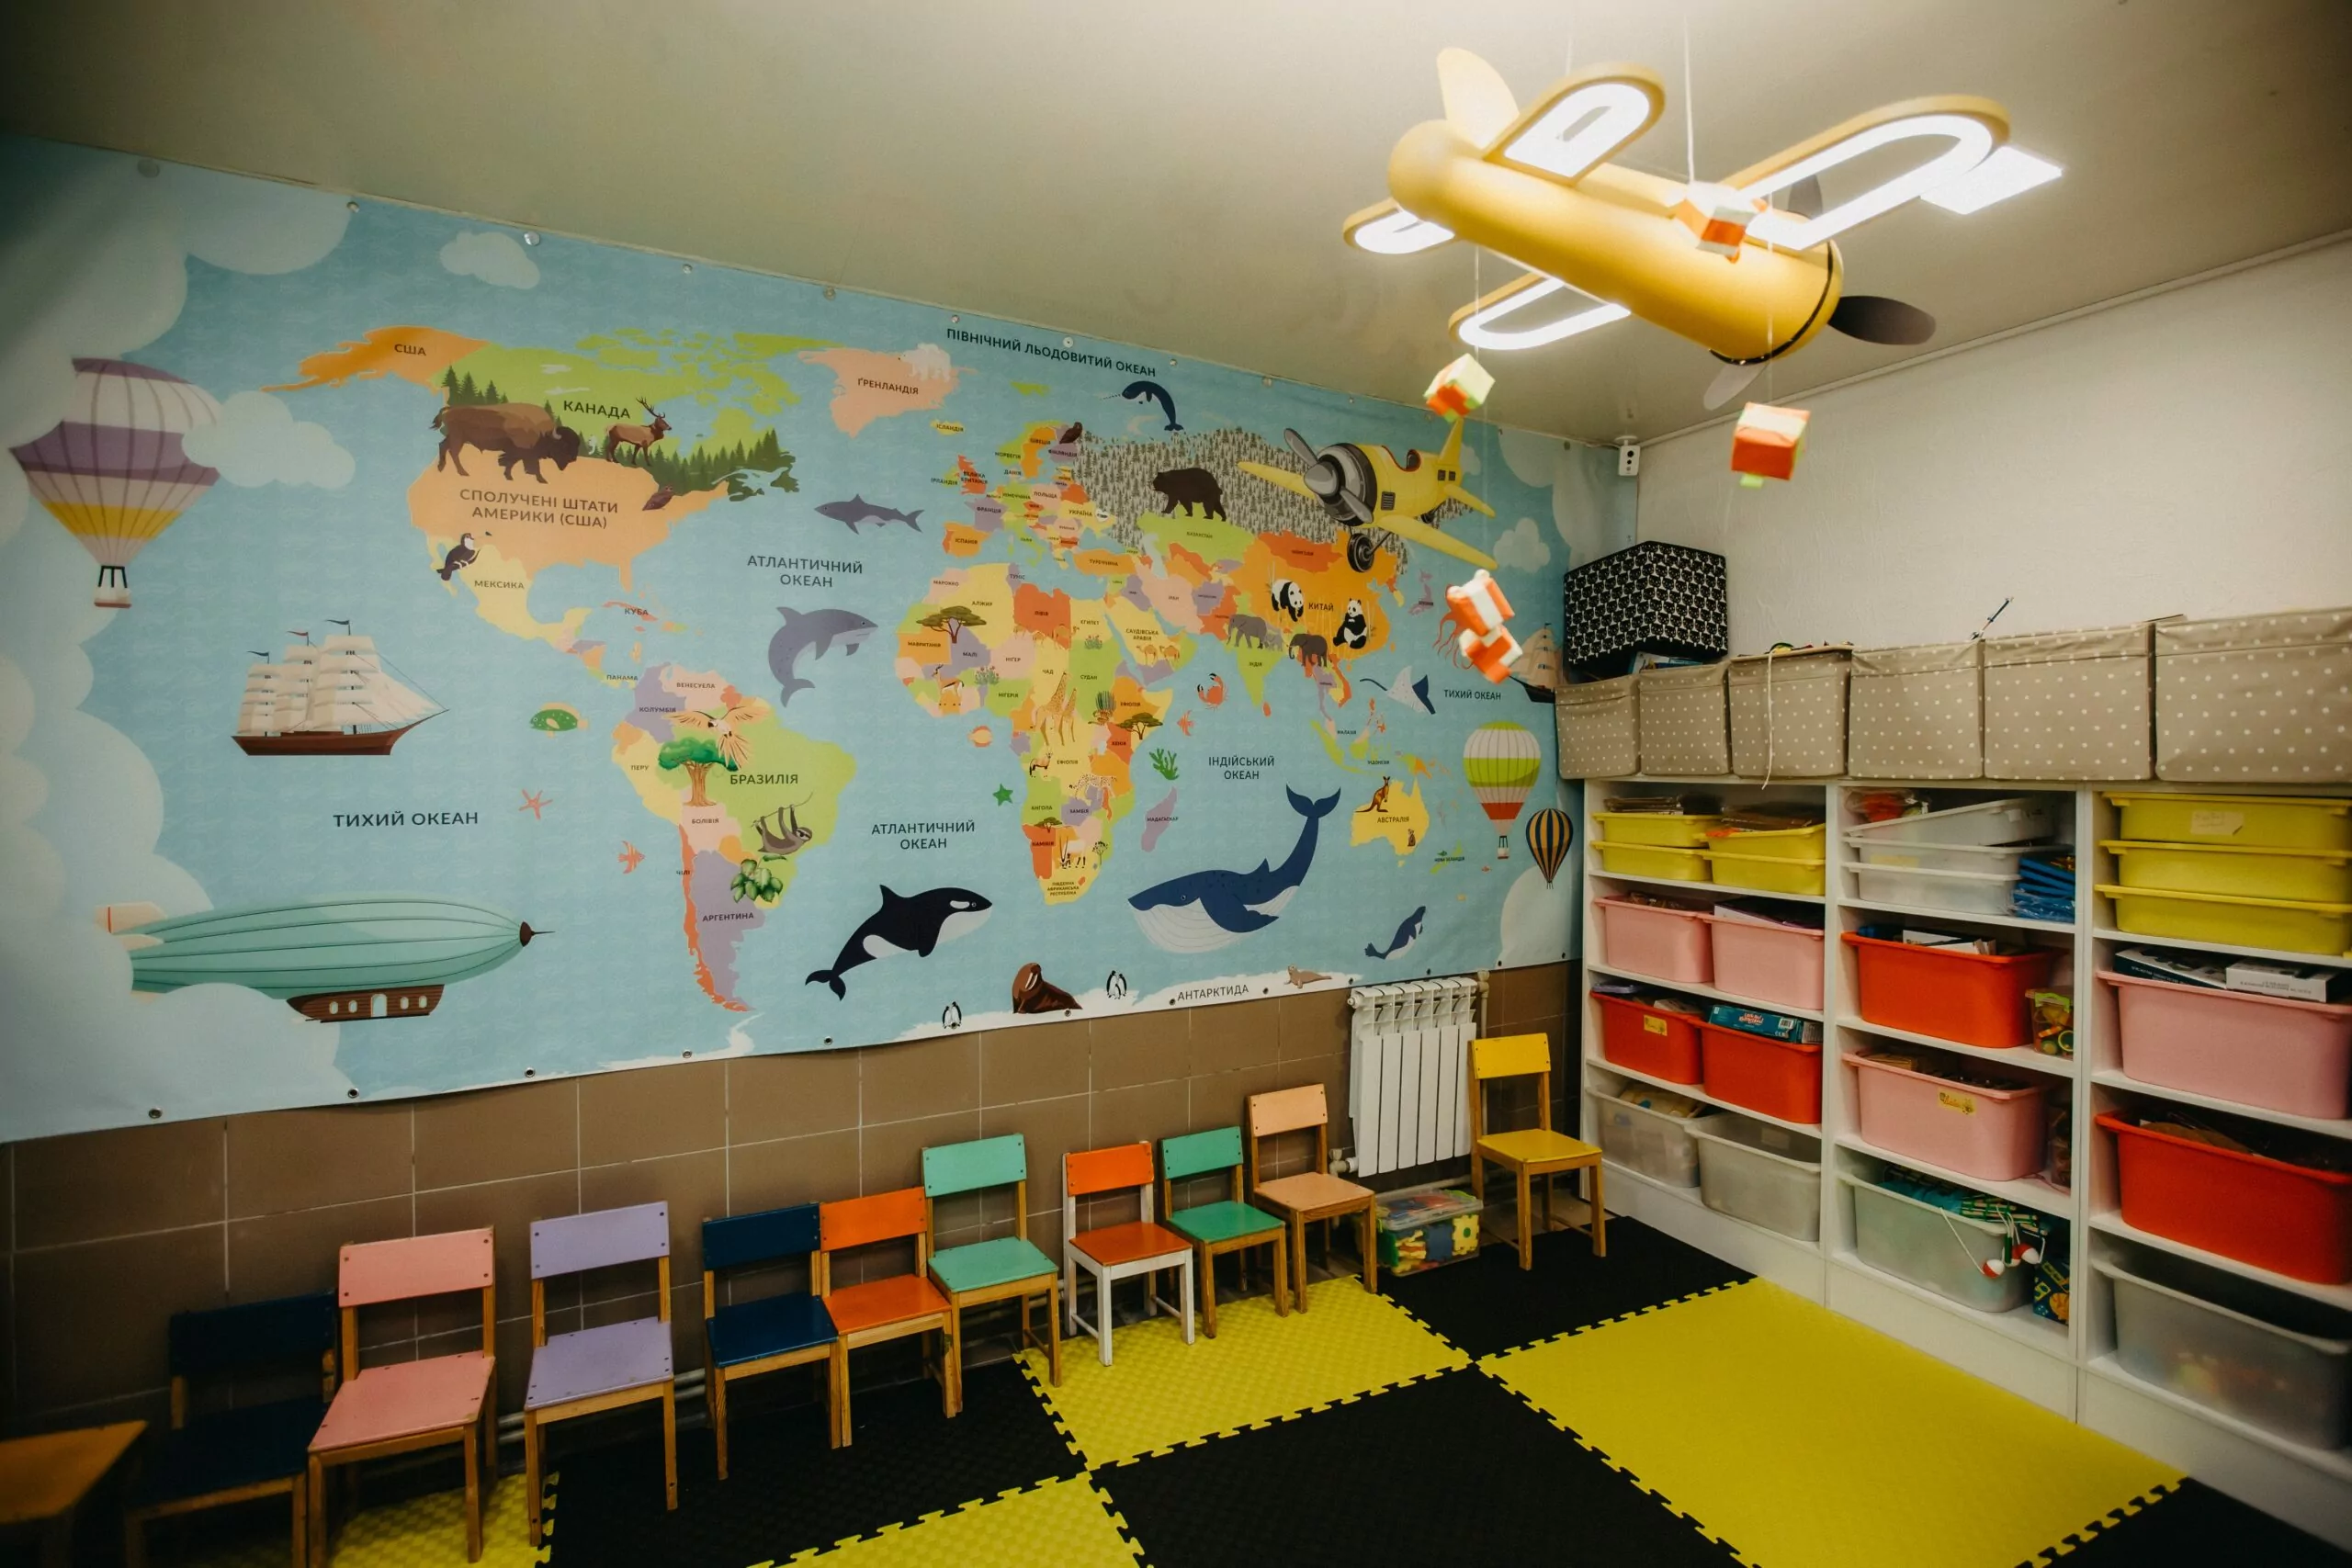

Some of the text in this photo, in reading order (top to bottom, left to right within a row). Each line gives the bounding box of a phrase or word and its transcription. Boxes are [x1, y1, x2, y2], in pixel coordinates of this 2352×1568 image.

[394, 344, 427, 356] США
[946, 327, 1156, 378] ПІВНІЧНИЙ ЛЬОДОВИТИЙ ОКЕАН
[856, 376, 919, 395] ҐРЕНЛАНДІЯ
[563, 400, 630, 420] КАНАДА
[936, 423, 964, 433] ІСЛАНДІЯ
[459, 488, 619, 513] СПОЛУЧЕНІ ШТАТИ
[471, 507, 608, 530] АМЕРИКИ (США)
[1069, 509, 1092, 517] УКРАЇНА
[747, 555, 864, 574] АТЛАНТИЧНИЙ
[474, 580, 525, 590] МЕКСИКА
[779, 574, 833, 588] ОКЕАН
[624, 607, 649, 615] КУБА
[1308, 602, 1334, 612] КИТАЙ
[1443, 689, 1501, 701] ТИХИЙ ОКЕАН
[1208, 755, 1275, 768] ІНДІЙСЬКИЙ
[729, 773, 798, 785] БРАЗИЛІЯ
[1223, 769, 1260, 780] ОКЕАН
[333, 810, 478, 828] ТИХИЙ ОКЕАН
[1376, 816, 1409, 824] АВСТРАЛІЯ
[871, 819, 975, 836] АТЛАНТИЧНИЙ
[899, 838, 947, 850] ОКЕАН
[702, 911, 754, 922] АРГЕНТИНА
[1177, 984, 1250, 1001] АНТАРКТИДА
